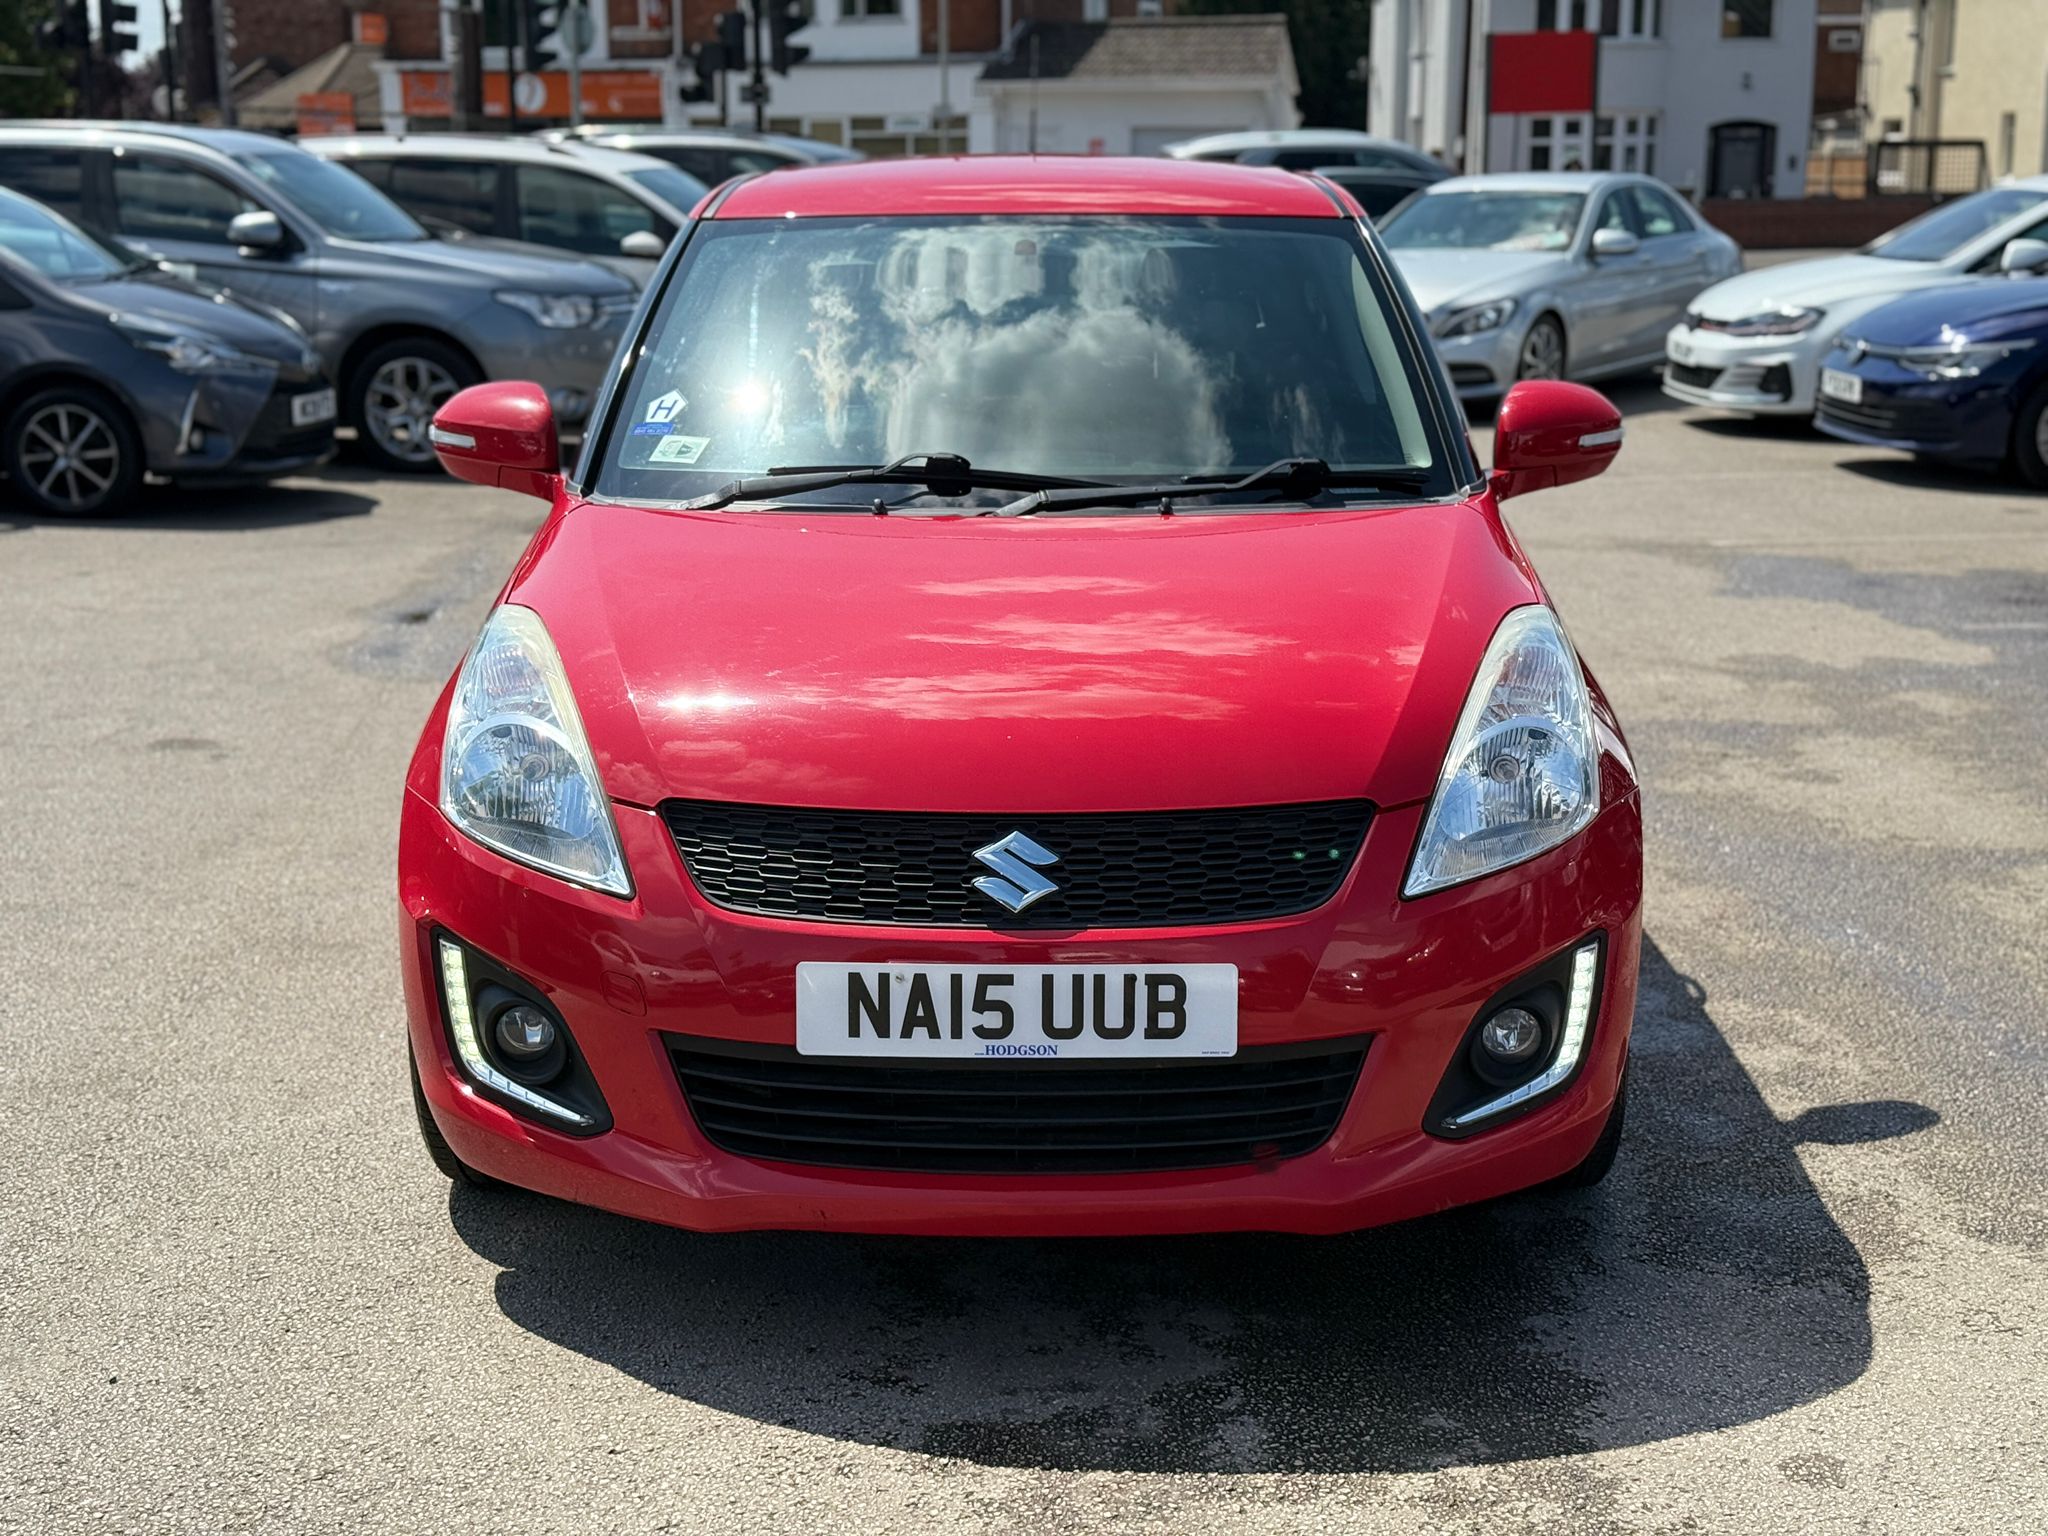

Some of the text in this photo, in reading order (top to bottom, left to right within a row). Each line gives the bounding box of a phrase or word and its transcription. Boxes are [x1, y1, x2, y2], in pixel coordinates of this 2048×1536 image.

[650, 399, 679, 419] H
[848, 971, 1187, 1040] NA15 UUB
[984, 1044, 1058, 1056] HODGSON
